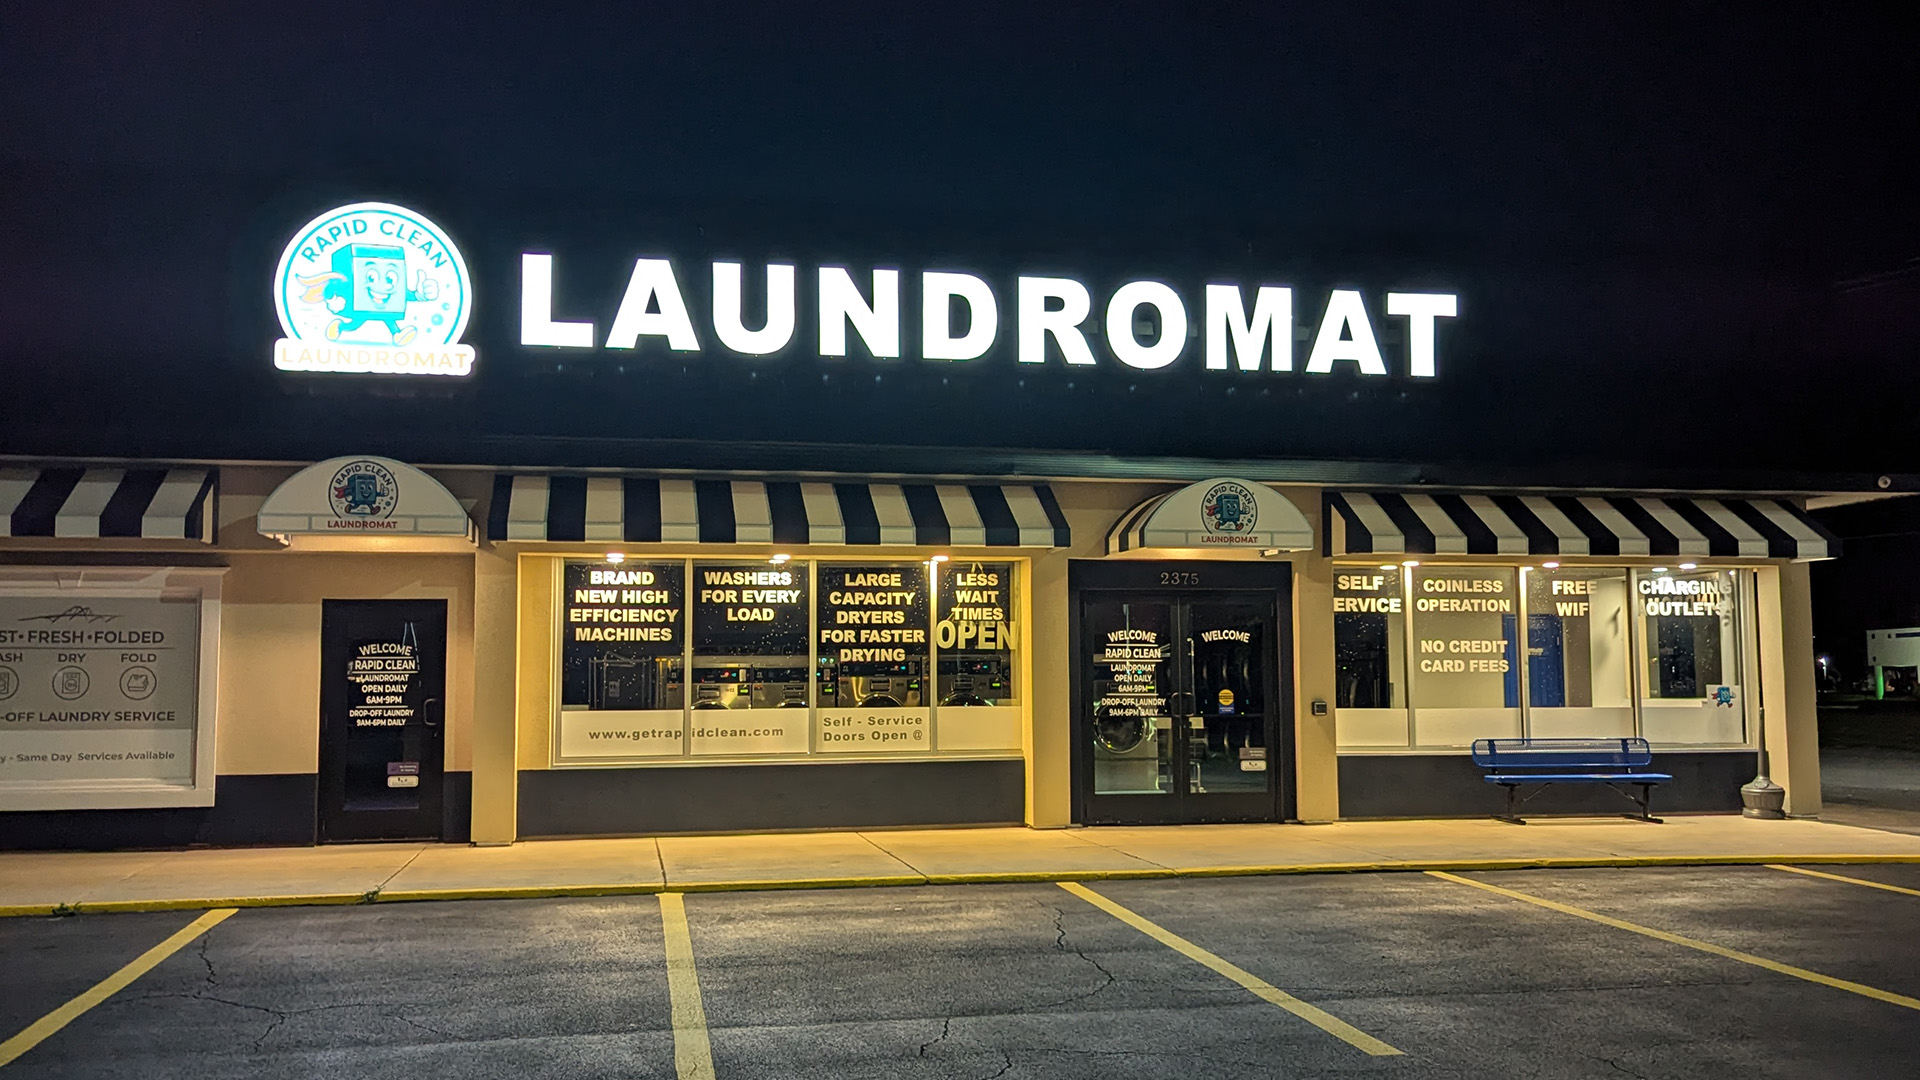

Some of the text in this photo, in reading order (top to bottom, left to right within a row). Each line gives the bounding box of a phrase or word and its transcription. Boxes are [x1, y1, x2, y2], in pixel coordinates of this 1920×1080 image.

[301, 219, 448, 268] RAPID CLEAN
[520, 253, 1458, 377] LAUNDROMAT
[282, 347, 467, 369] LAUNDROMAT
[335, 465, 393, 486] RAPID CLEAN
[1206, 486, 1252, 504] RAPID CLEAN
[328, 520, 398, 529] LAUNDROMAT
[590, 571, 655, 585] BRAND
[704, 572, 792, 586] WASHERS
[845, 573, 902, 587] LARGE
[956, 573, 998, 586] LESS
[1160, 572, 1200, 586] 2375
[1337, 575, 1384, 590] SELF
[1423, 579, 1504, 593] COINLESS
[1552, 580, 1597, 595] FREE
[1639, 580, 1732, 595] CHARGING
[575, 590, 668, 604] NEW HIGH
[701, 590, 801, 603] FOR EVERY
[829, 591, 915, 605] CAPACITY
[955, 590, 999, 603] WAIT
[1333, 598, 1402, 612] ERVICE
[1416, 598, 1510, 612] OPERATION
[1556, 602, 1588, 617] WIF
[570, 608, 679, 622] EFFICIENCY
[727, 608, 775, 622] LOAD
[836, 611, 905, 624] DRYERS
[951, 607, 1004, 620] TIMES
[28, 630, 84, 643] FRESH
[94, 631, 165, 644] FOLDED
[575, 628, 673, 642] MACHINES
[821, 630, 925, 643] FOR FASTER
[936, 620, 1016, 650] OPEN
[1108, 629, 1157, 643] WELCOME
[1201, 629, 1250, 643] WELCOME
[359, 643, 412, 656] WELCOME
[1105, 648, 1161, 658] RAPID CLEAN
[1420, 640, 1508, 653] NO CREDIT
[58, 653, 86, 662] DRY
[121, 653, 157, 662] FOLD
[840, 648, 906, 662] DRYING
[355, 660, 416, 670] RAPID CLEAN
[1110, 664, 1156, 672] LAUNDROMAT
[1420, 660, 1509, 673] CARD FEES
[360, 674, 409, 682] LAUNDROMAT
[1114, 674, 1152, 682] OPEN DAILY
[361, 685, 408, 693] OPEN DAILY
[1118, 684, 1148, 692] 6AM-9PM
[366, 696, 402, 704] 6AM-9PM
[1102, 698, 1166, 706] DROP-OFF LAUNDRY
[39, 711, 111, 722] LAUNDRY
[114, 711, 175, 721] SERVICE
[350, 709, 414, 717] DROP-OFF LAUNDRY
[1109, 708, 1139, 716] 9AM-6PM
[823, 717, 852, 727] Self
[868, 716, 922, 726] Service
[824, 730, 922, 742] Doors Open @
[16, 753, 48, 762] Same
[51, 752, 72, 763] Day
[78, 752, 123, 761] Services
[126, 751, 175, 760] Available
